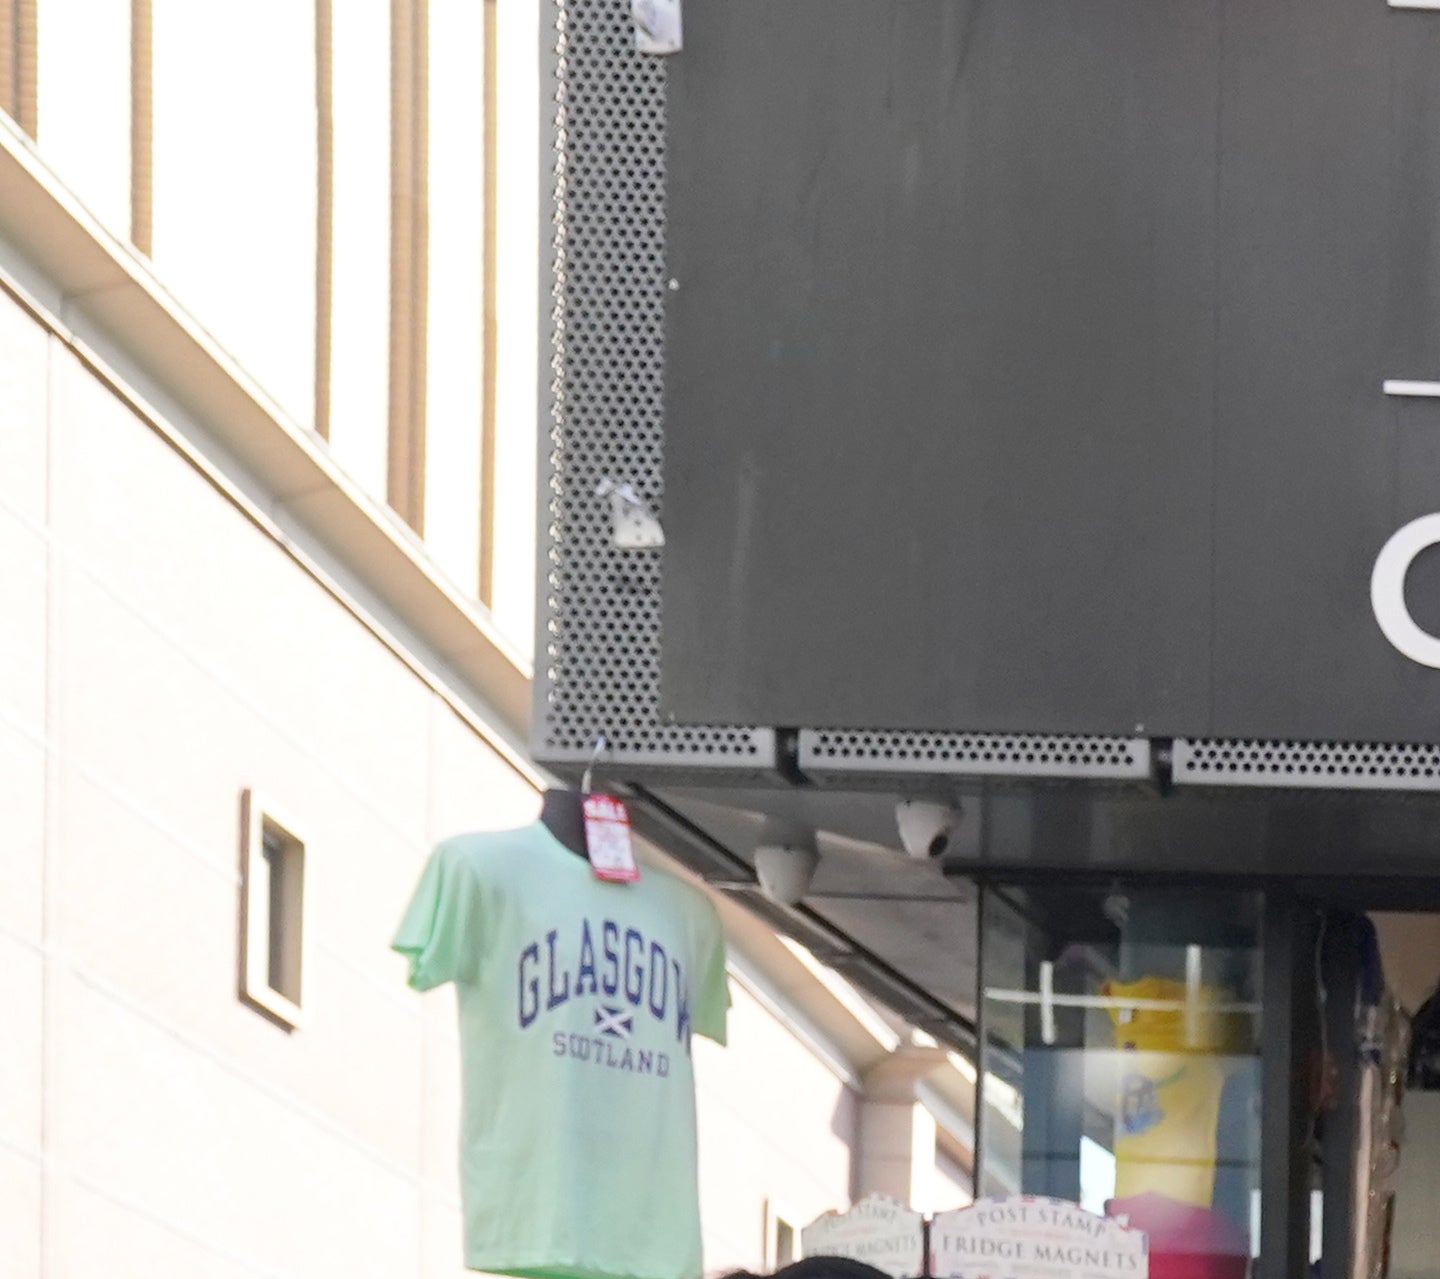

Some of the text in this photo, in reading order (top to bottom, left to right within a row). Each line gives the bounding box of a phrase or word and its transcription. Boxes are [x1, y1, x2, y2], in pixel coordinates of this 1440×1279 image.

[517, 917, 696, 1060] GLASGOW
[552, 1029, 672, 1079] SCOTLAND
[975, 1205, 1107, 1238] POST STAMP
[942, 1234, 1139, 1272] FRIDGE MAGNETS
